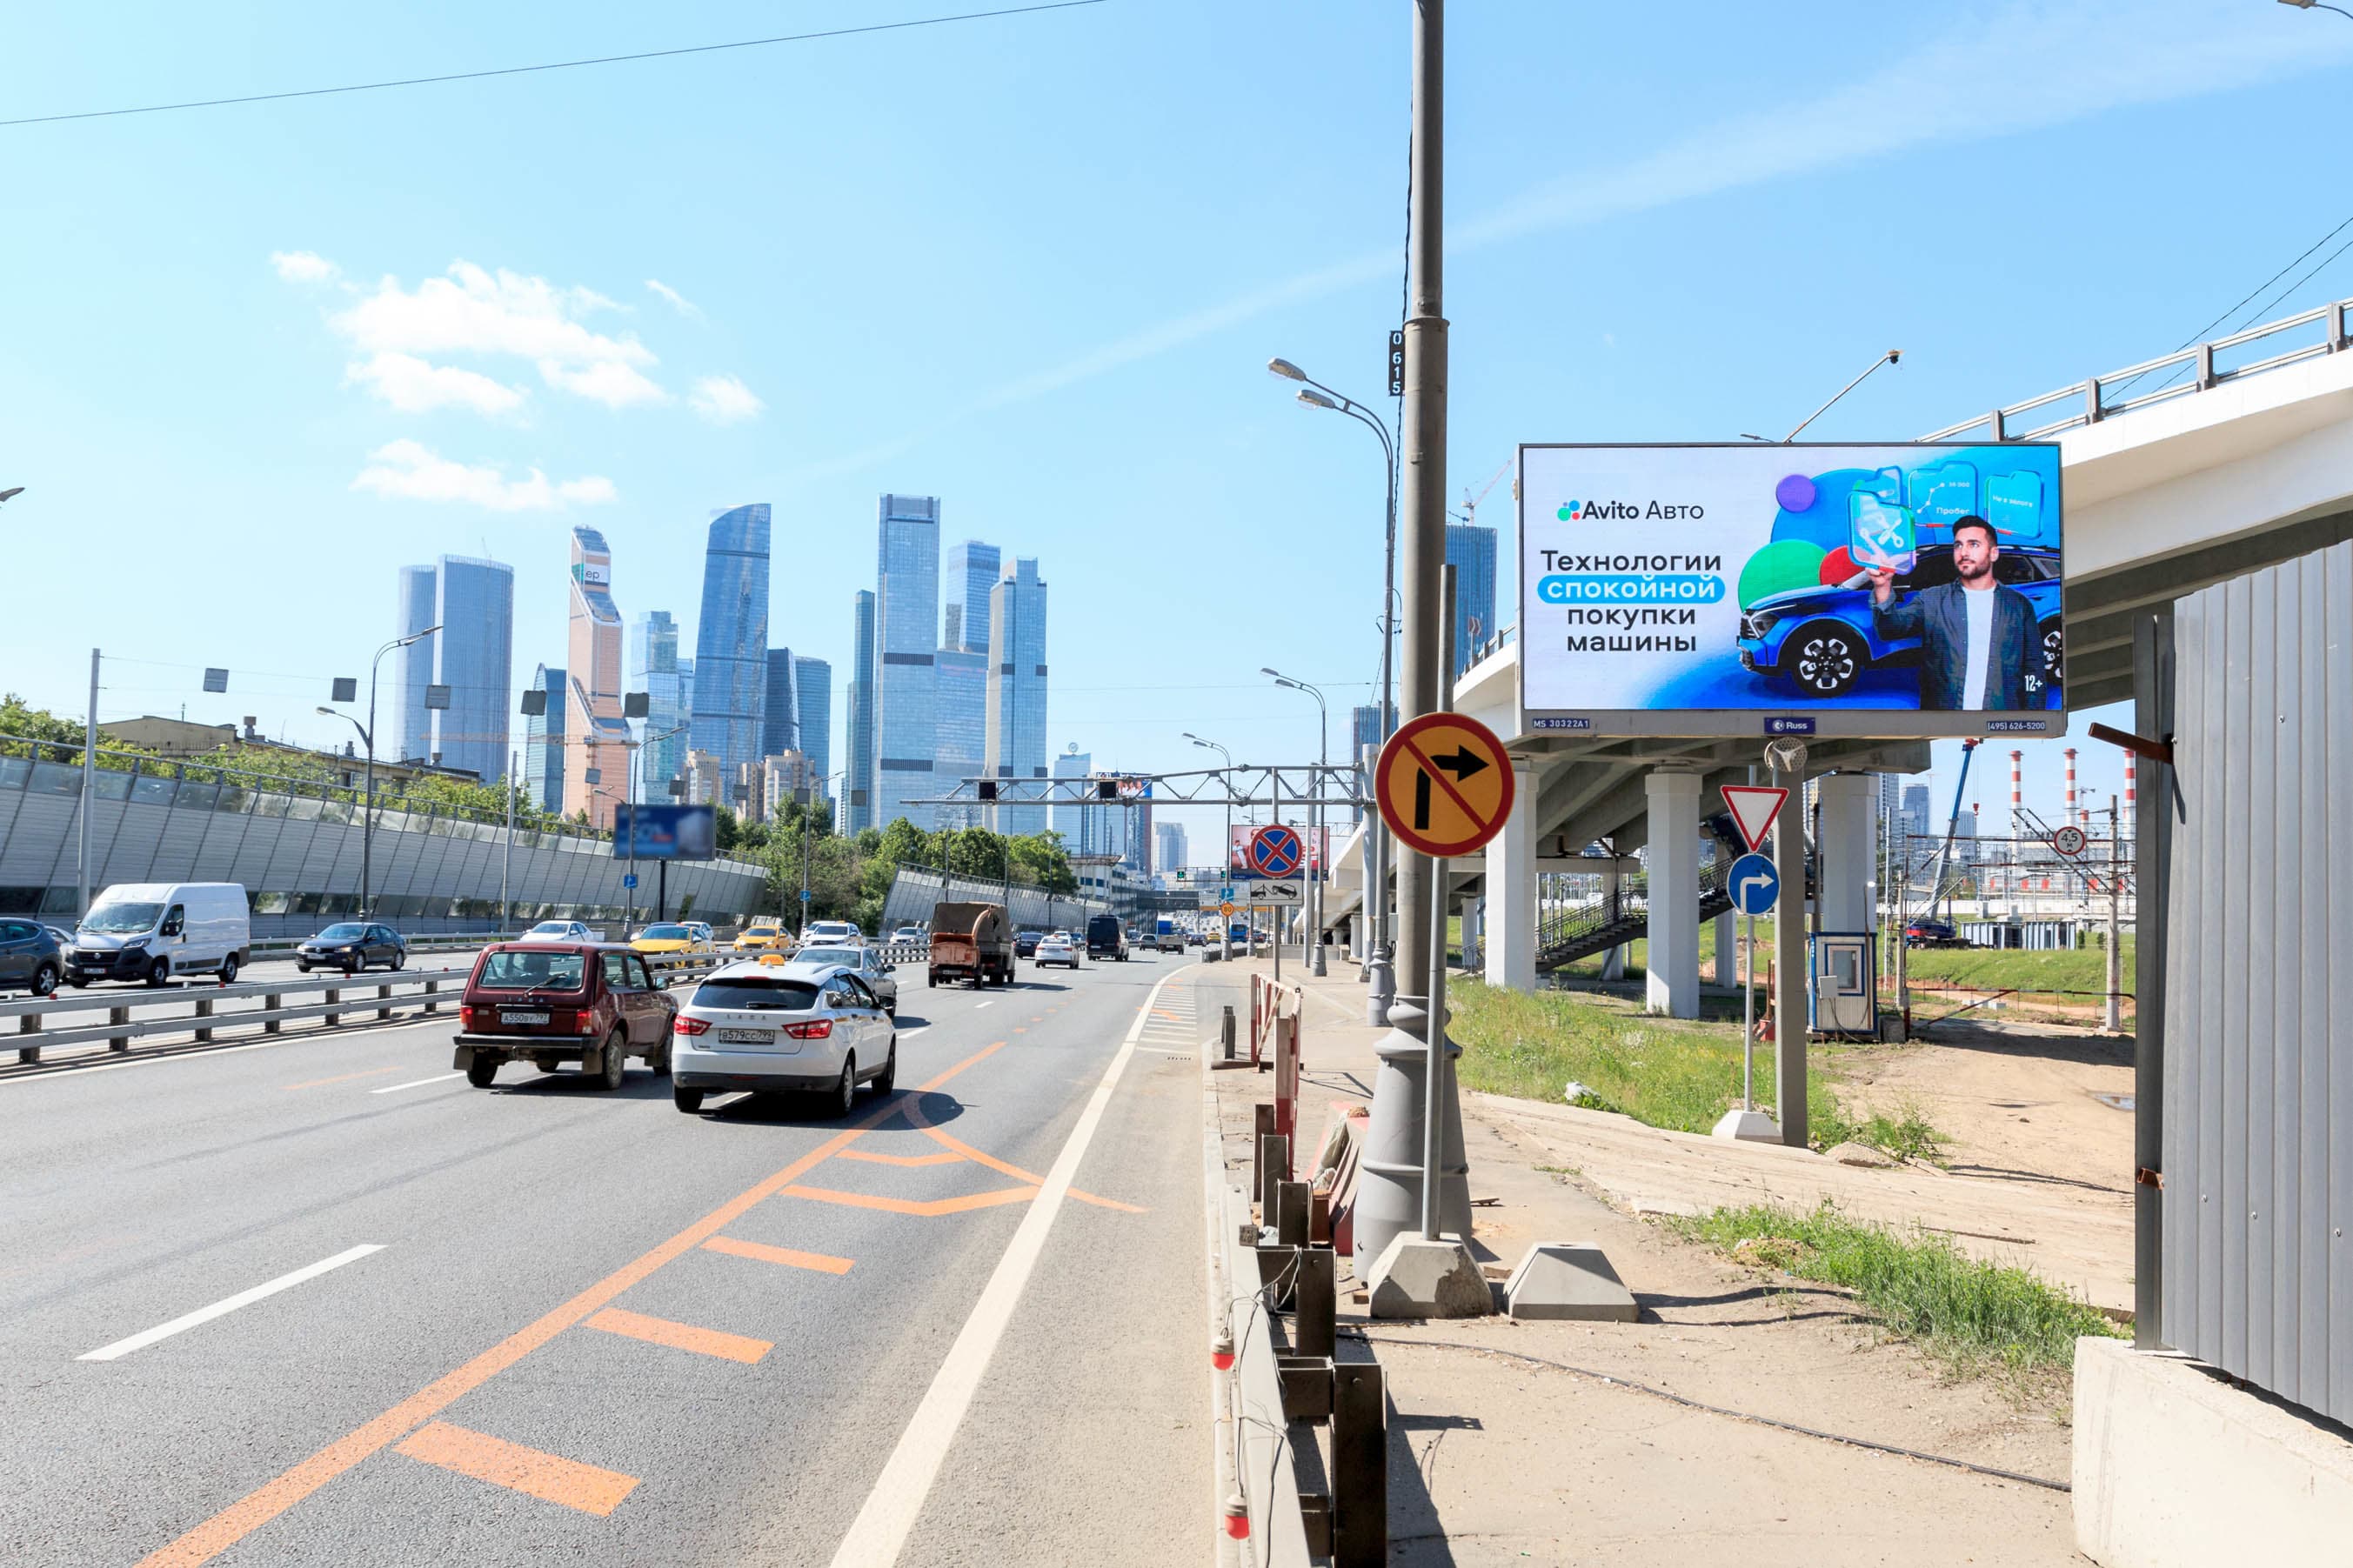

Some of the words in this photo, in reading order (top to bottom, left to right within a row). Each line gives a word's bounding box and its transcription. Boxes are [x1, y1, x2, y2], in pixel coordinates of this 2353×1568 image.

[1581, 500, 1640, 519] Avito
[1645, 500, 1704, 519] Авто
[1936, 507, 1969, 516] Пробег
[1541, 550, 1721, 571] Технологии
[1547, 574, 1715, 598] спокойной
[1568, 609, 1695, 631] покупки
[1568, 636, 1696, 651] машины
[2024, 675, 2042, 691] 12+
[2061, 832, 2078, 843] 4,5
